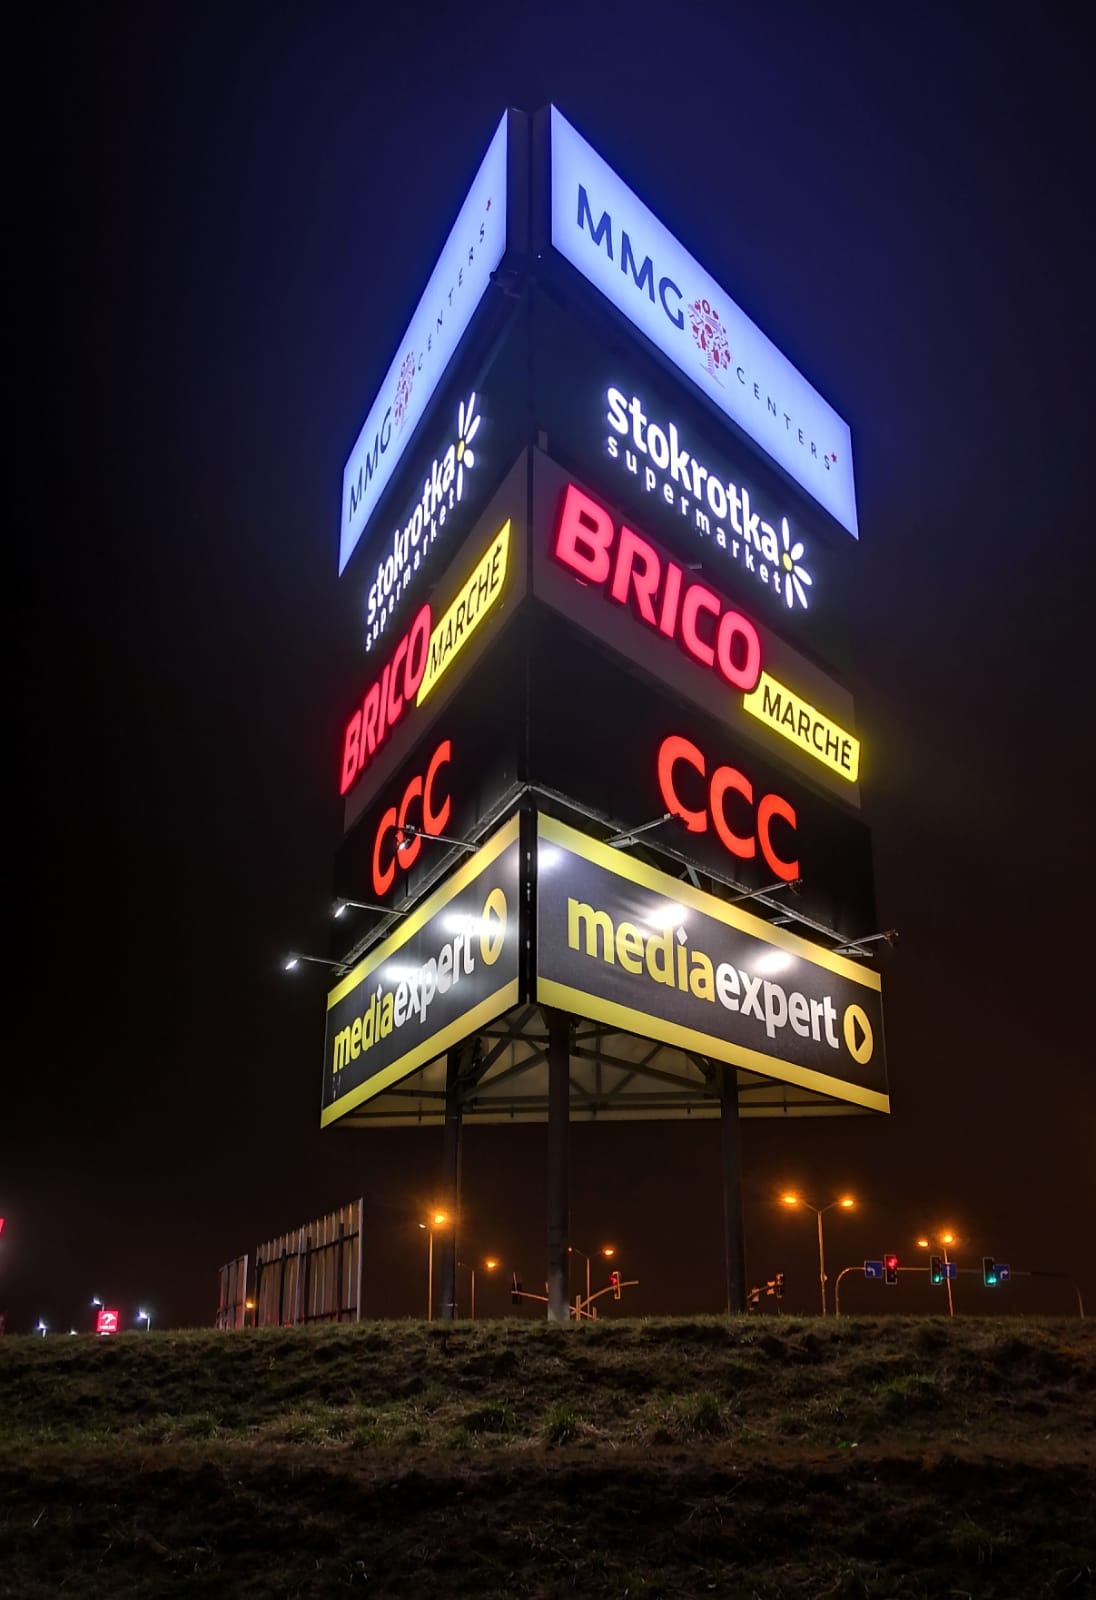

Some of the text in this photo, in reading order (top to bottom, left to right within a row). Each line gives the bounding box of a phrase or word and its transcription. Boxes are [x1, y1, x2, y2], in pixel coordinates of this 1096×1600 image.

[349, 222, 484, 523] MMG CENTERS
[577, 183, 830, 470] MMG CENTERS
[367, 444, 456, 626] stokrotka
[607, 387, 779, 567] stokrotka
[607, 436, 782, 594] supermarket
[365, 488, 455, 653] supermarket
[555, 483, 852, 771] BRICO MARCHÉ
[340, 543, 503, 796] BRICO MARCHÉ
[373, 739, 451, 896] CCC
[658, 735, 800, 882] CCC
[332, 913, 475, 1074] mediaexpert
[567, 897, 839, 1049] mediaexpert
